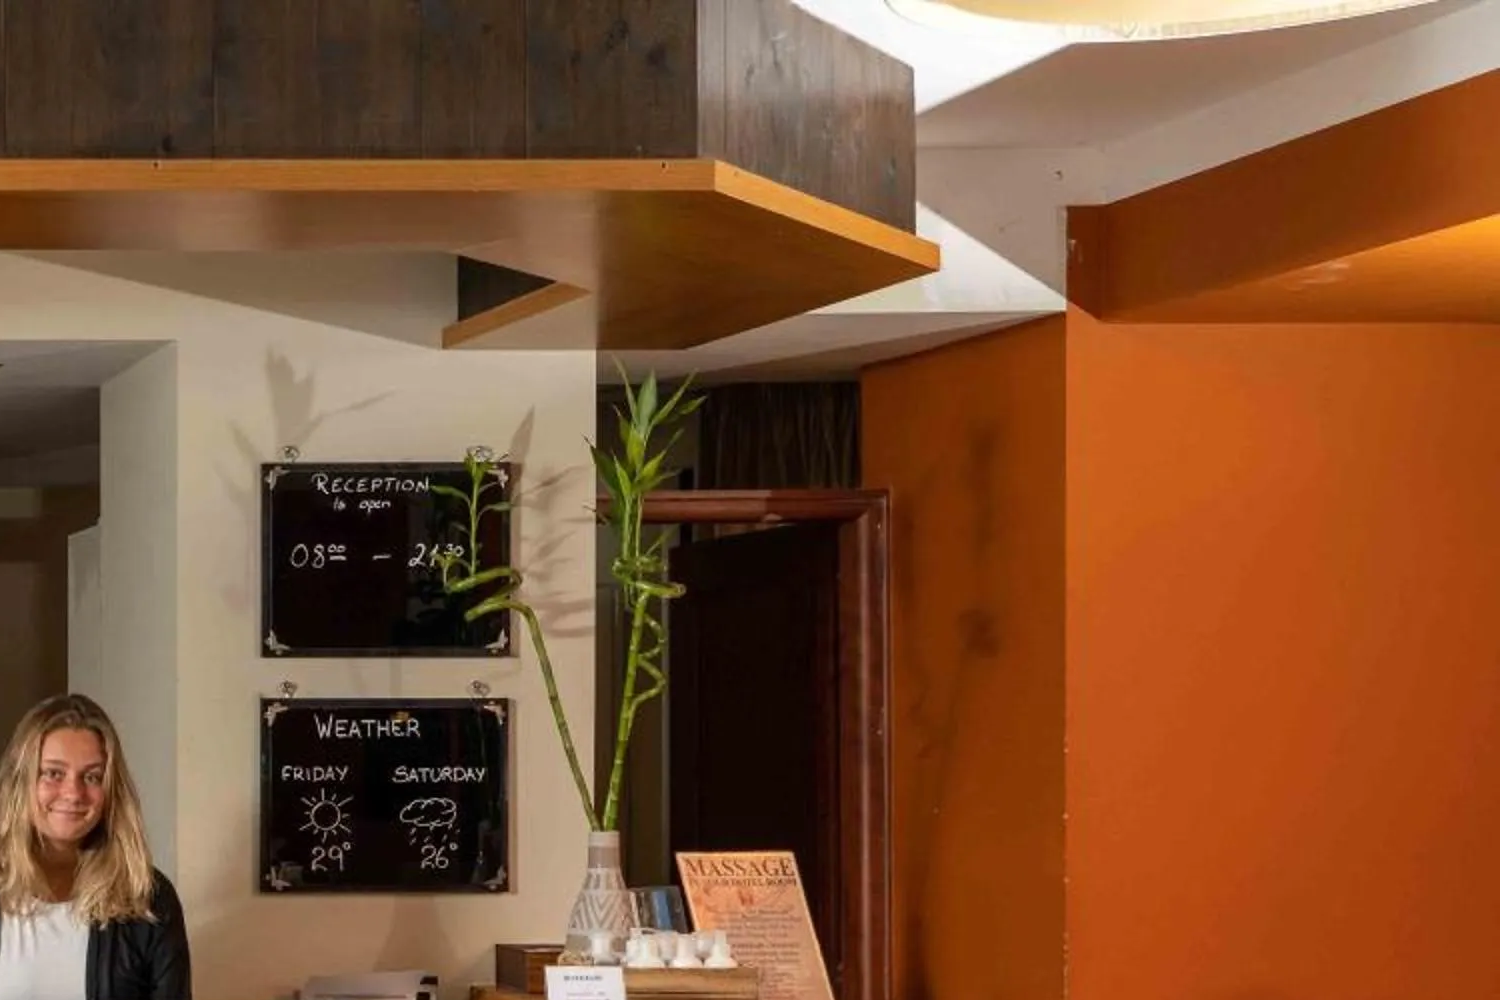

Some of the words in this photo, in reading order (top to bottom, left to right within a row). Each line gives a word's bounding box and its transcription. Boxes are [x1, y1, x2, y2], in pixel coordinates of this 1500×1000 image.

[311, 473, 430, 495] RECEPTION
[358, 498, 392, 515] open
[312, 712, 421, 740] WEATHER
[280, 765, 349, 783] FRIDAY
[391, 766, 487, 784] SATURDAY
[685, 857, 795, 876] MASSAGE
